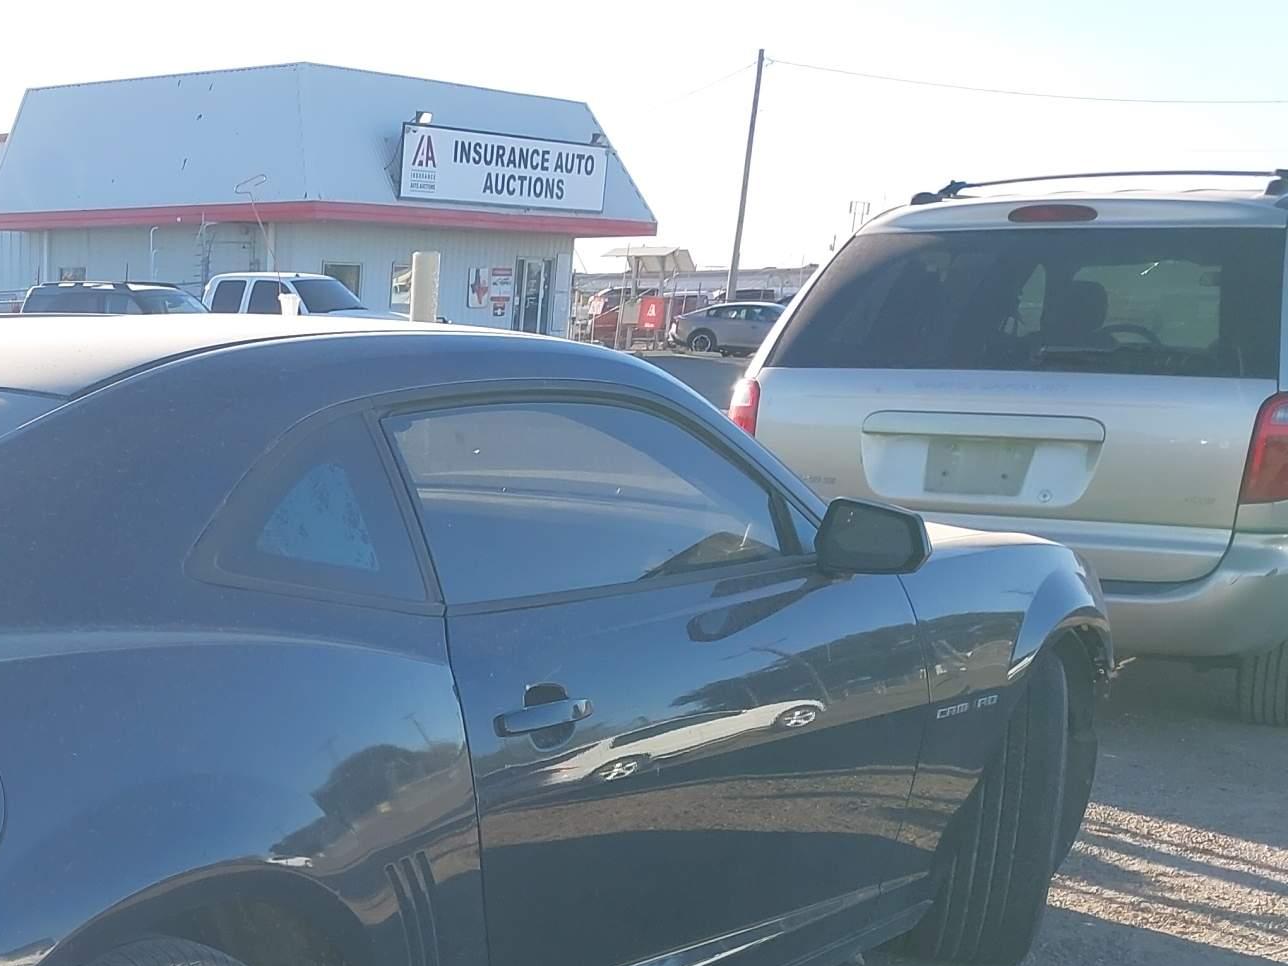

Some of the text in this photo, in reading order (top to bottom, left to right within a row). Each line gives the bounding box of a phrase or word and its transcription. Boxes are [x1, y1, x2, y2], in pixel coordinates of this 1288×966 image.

[453, 140, 595, 176] INSURANCE AUTO
[483, 172, 565, 200] AUCTIONS
